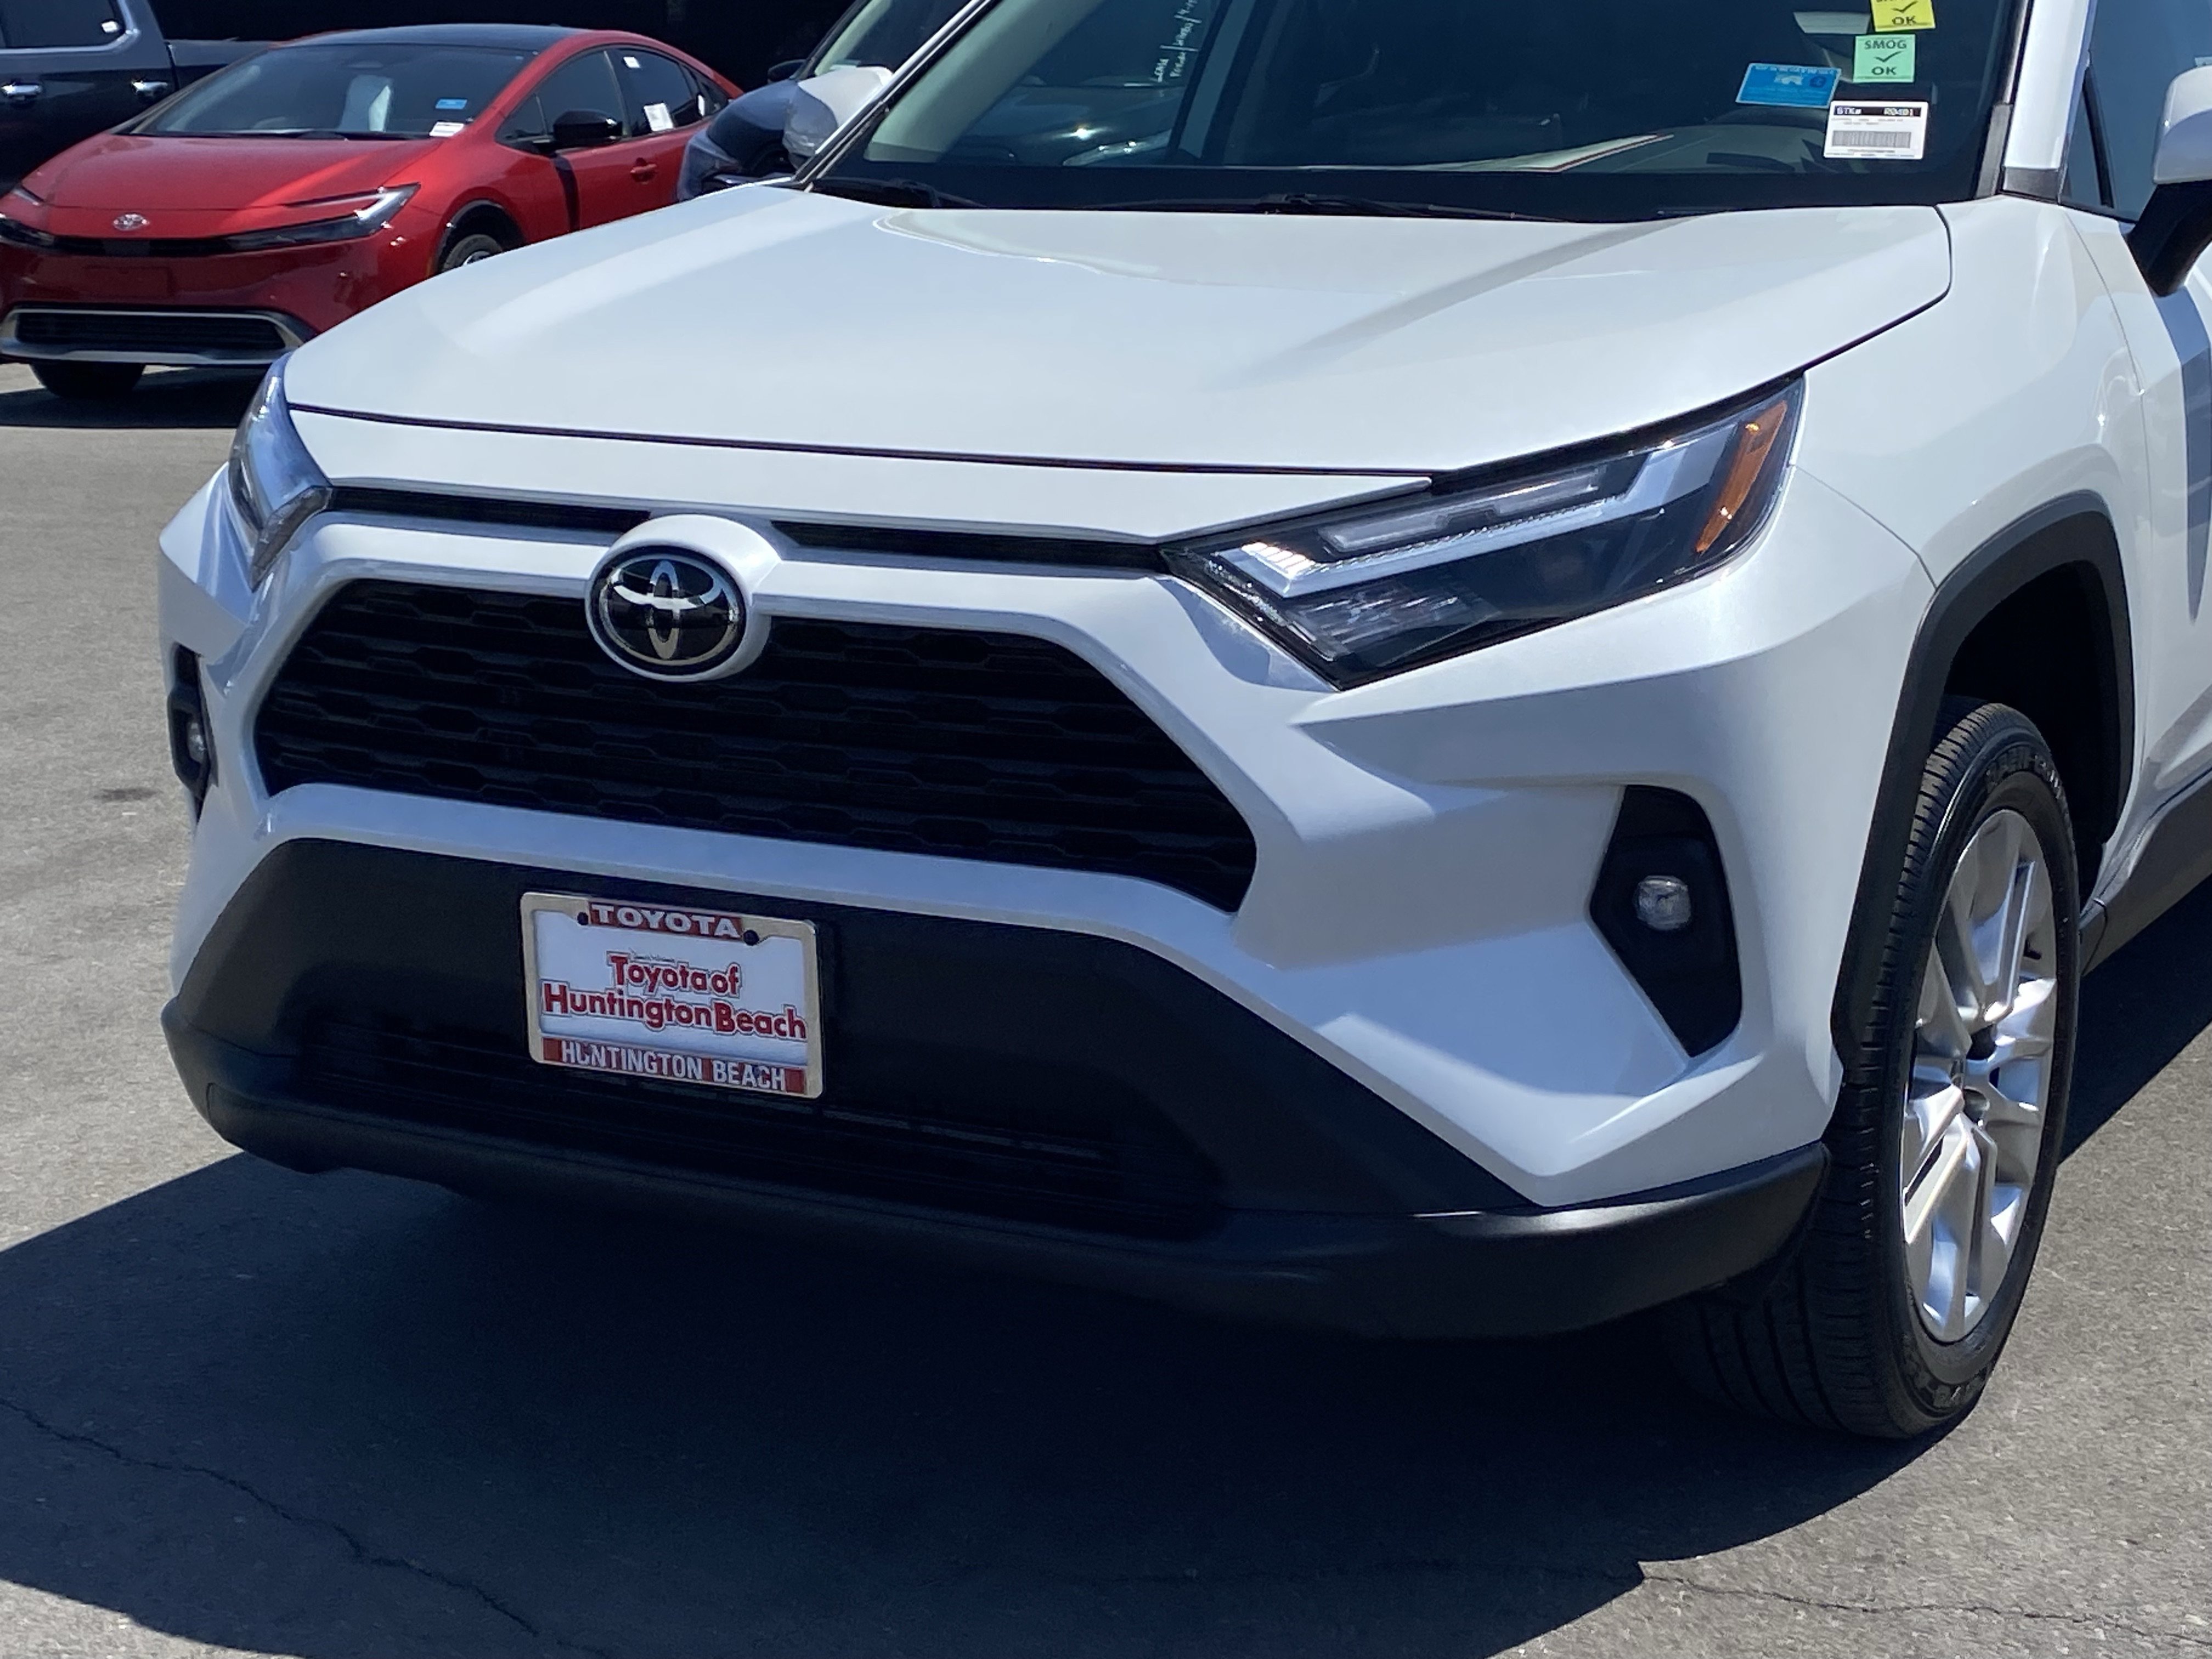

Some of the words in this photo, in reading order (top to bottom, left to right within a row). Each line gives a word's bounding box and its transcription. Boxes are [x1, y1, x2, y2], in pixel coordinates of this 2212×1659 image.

[1892, 15, 1917, 25] OK
[1865, 40, 1907, 49] SMOG
[1871, 66, 1897, 76] OK
[591, 904, 740, 938] TOYOTA
[610, 954, 708, 993] Toyota
[711, 966, 740, 996] of
[543, 982, 712, 1029] Huntington
[714, 1001, 806, 1039] Beach
[562, 1040, 703, 1081] HUNTINGTON
[712, 1059, 786, 1092] BEACH
